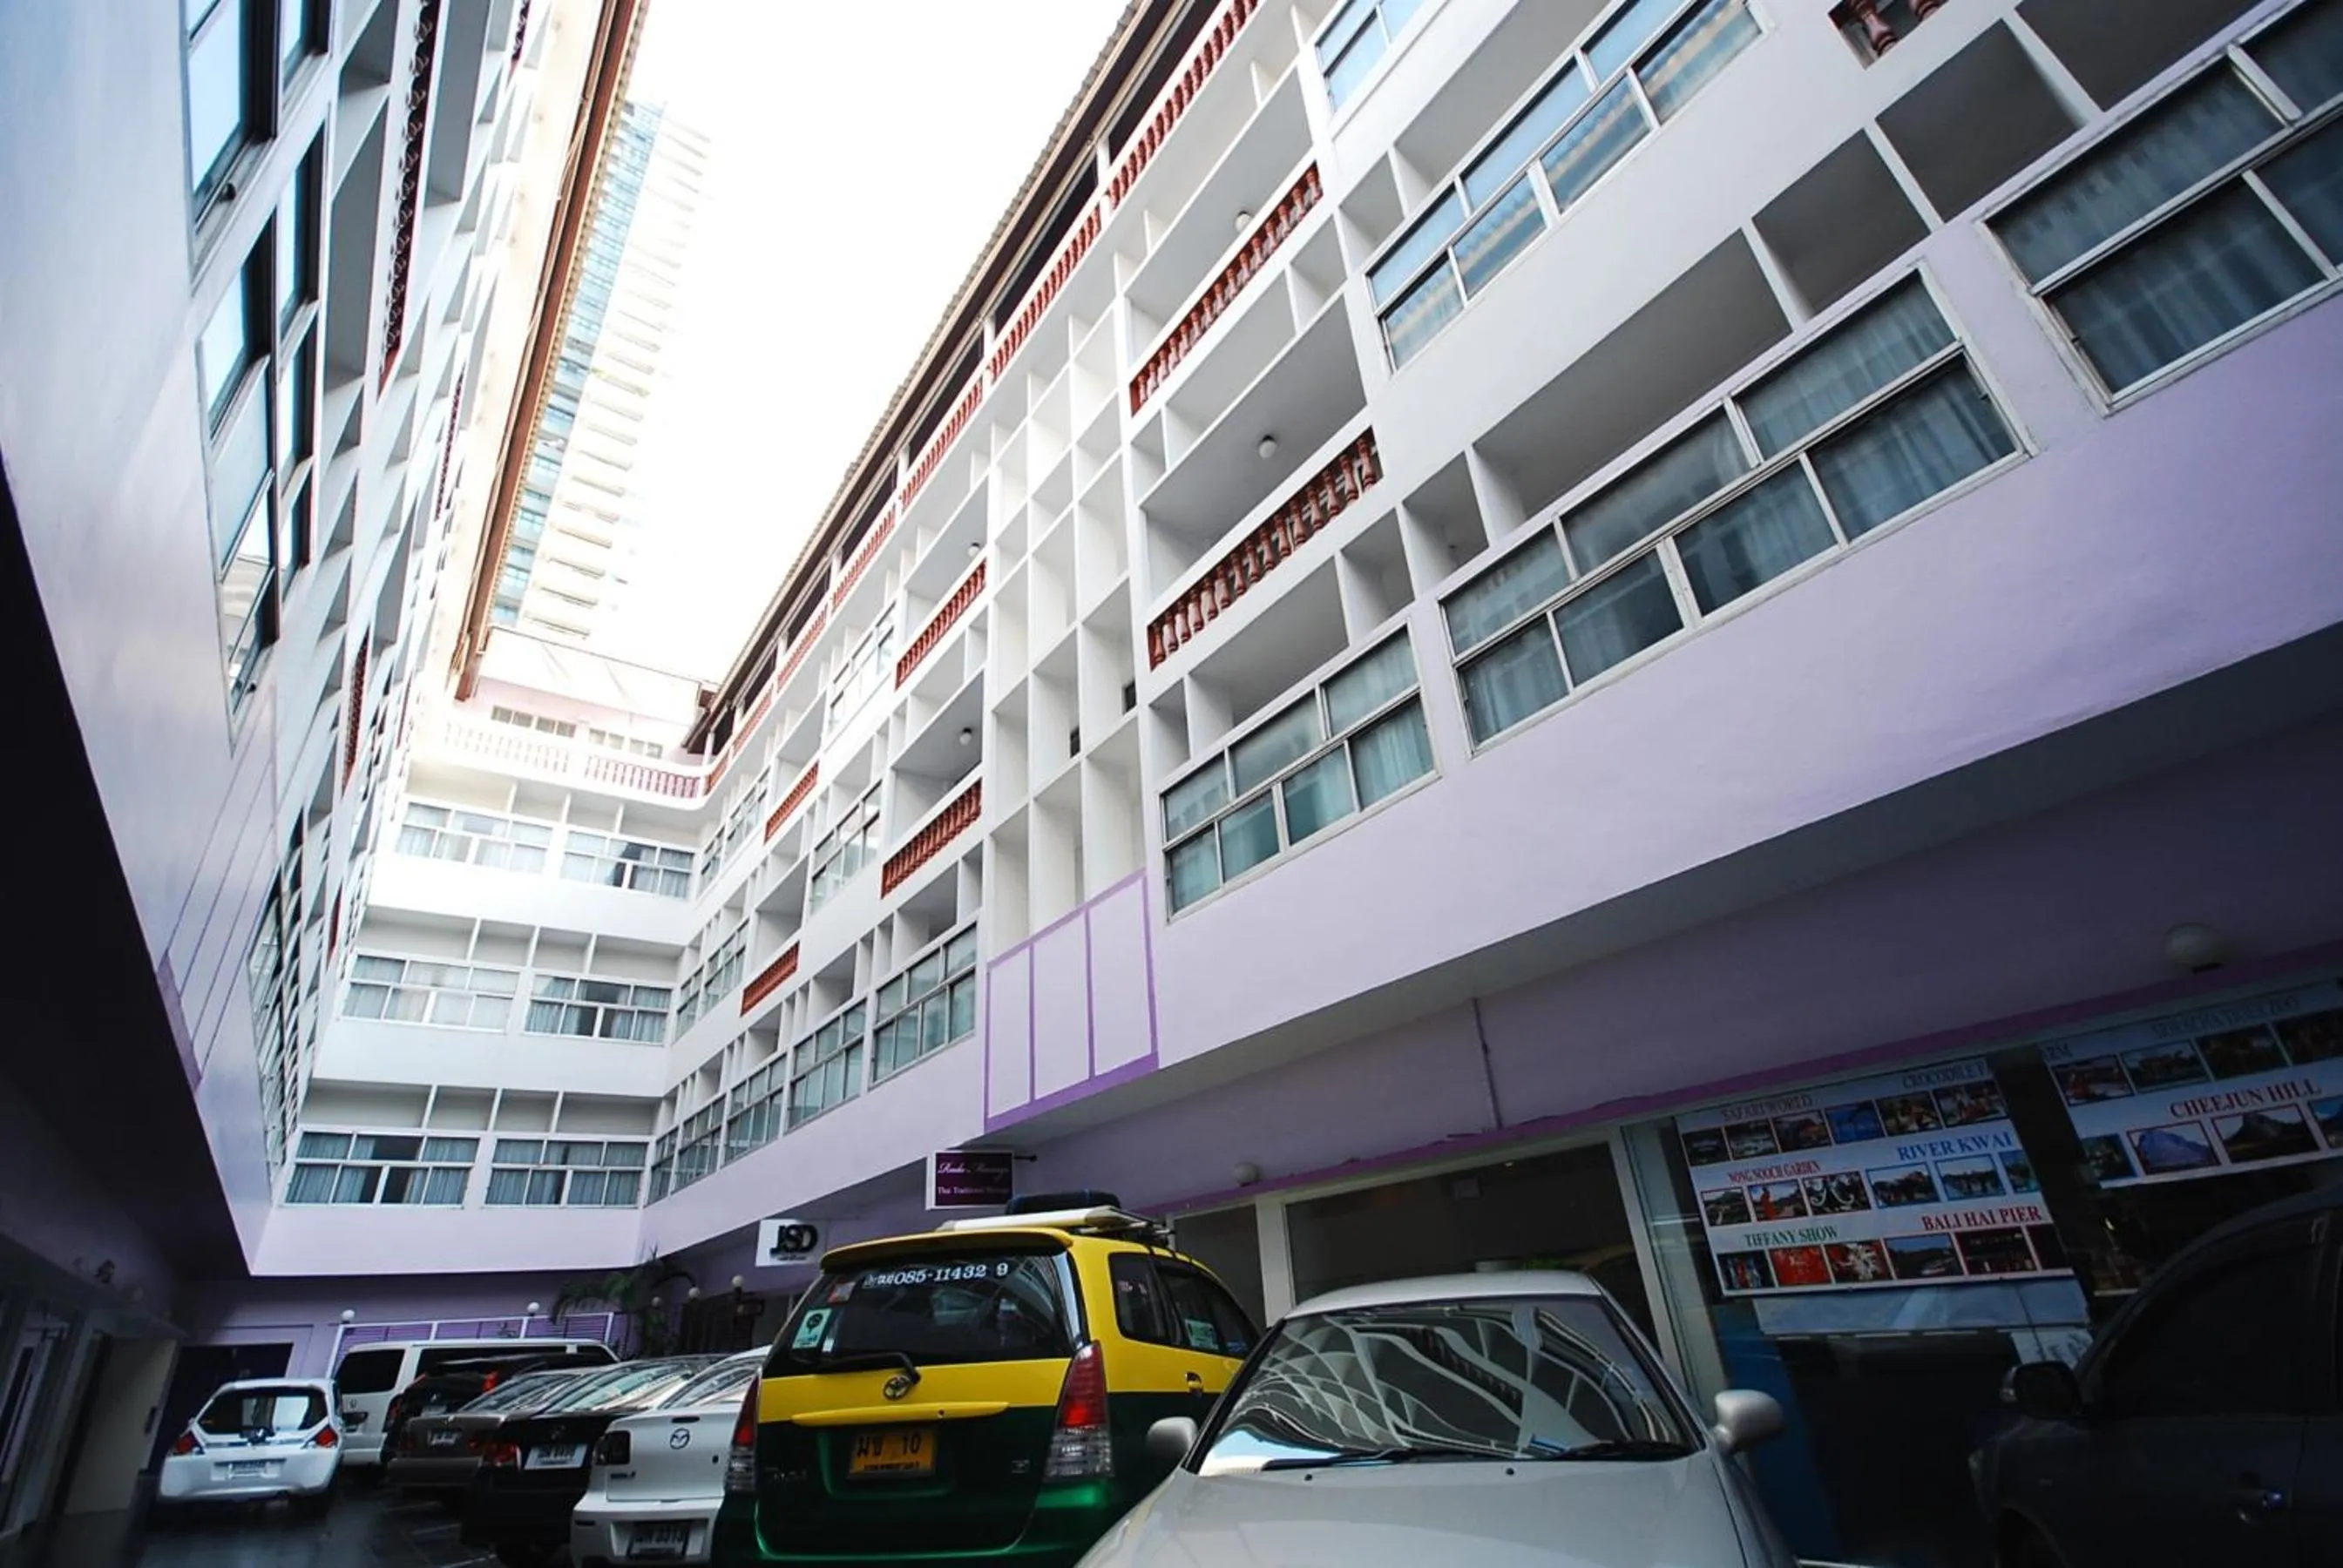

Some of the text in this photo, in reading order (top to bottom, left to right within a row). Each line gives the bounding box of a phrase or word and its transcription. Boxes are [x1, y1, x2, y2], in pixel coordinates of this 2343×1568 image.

[2170, 1078, 2322, 1118] CHEEJUN HILL
[1898, 1131, 2014, 1161] RIVER KWAI
[1922, 1206, 2043, 1231] BALI HAI PIER
[1744, 1225, 1839, 1247] TIFFANY SHOW
